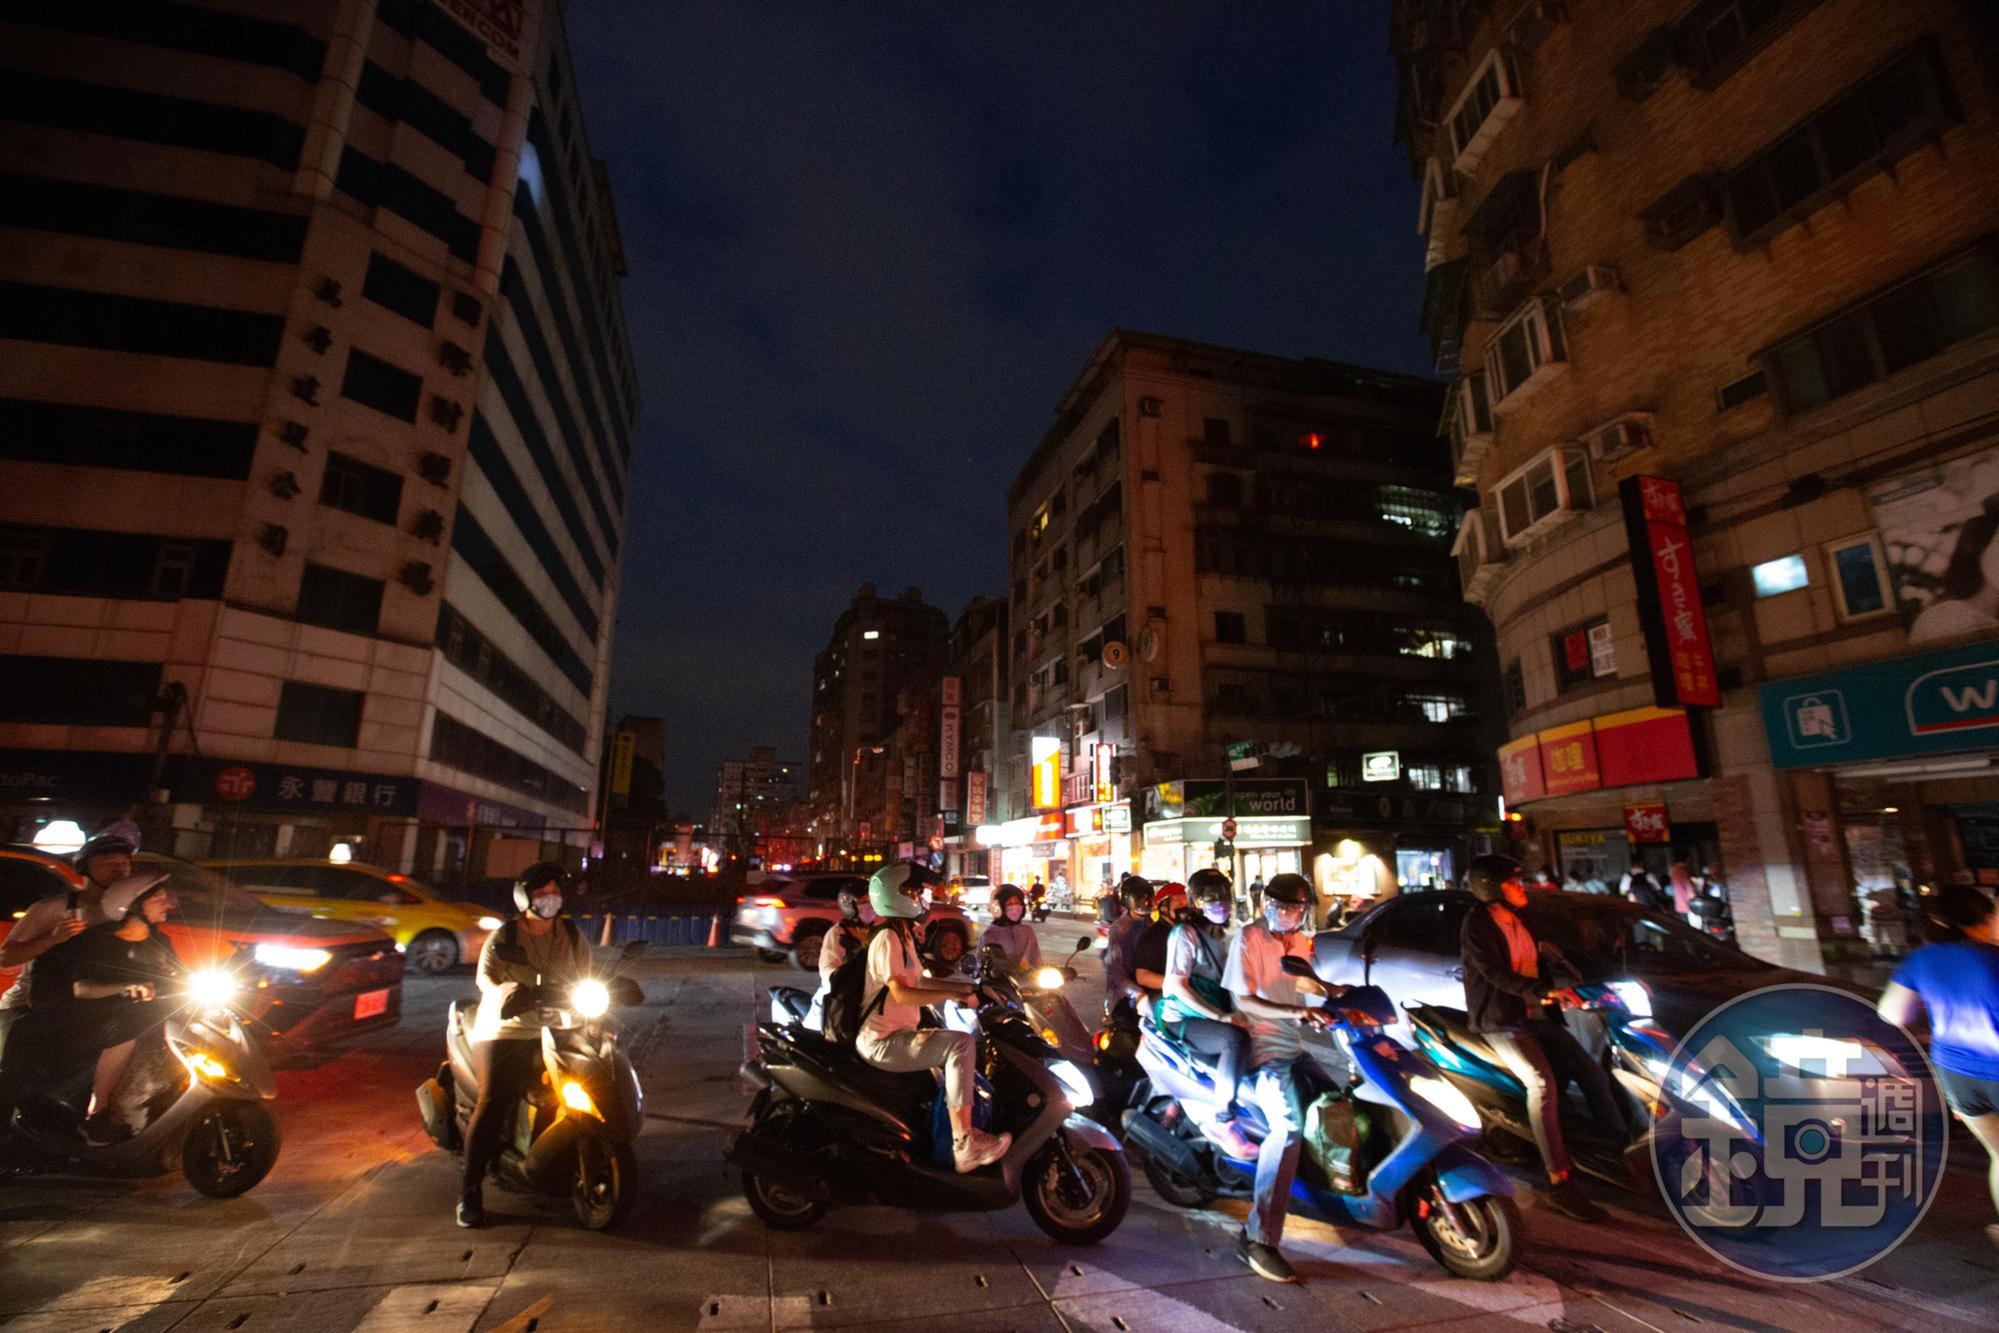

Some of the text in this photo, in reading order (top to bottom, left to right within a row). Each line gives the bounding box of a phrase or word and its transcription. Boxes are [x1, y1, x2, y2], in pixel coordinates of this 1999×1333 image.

[1656, 536, 1698, 646] すき家
[944, 723, 955, 772] KYMCO
[277, 774, 397, 807] 永豐銀行
[1248, 797, 1296, 812] world
[1260, 791, 1281, 801] your
